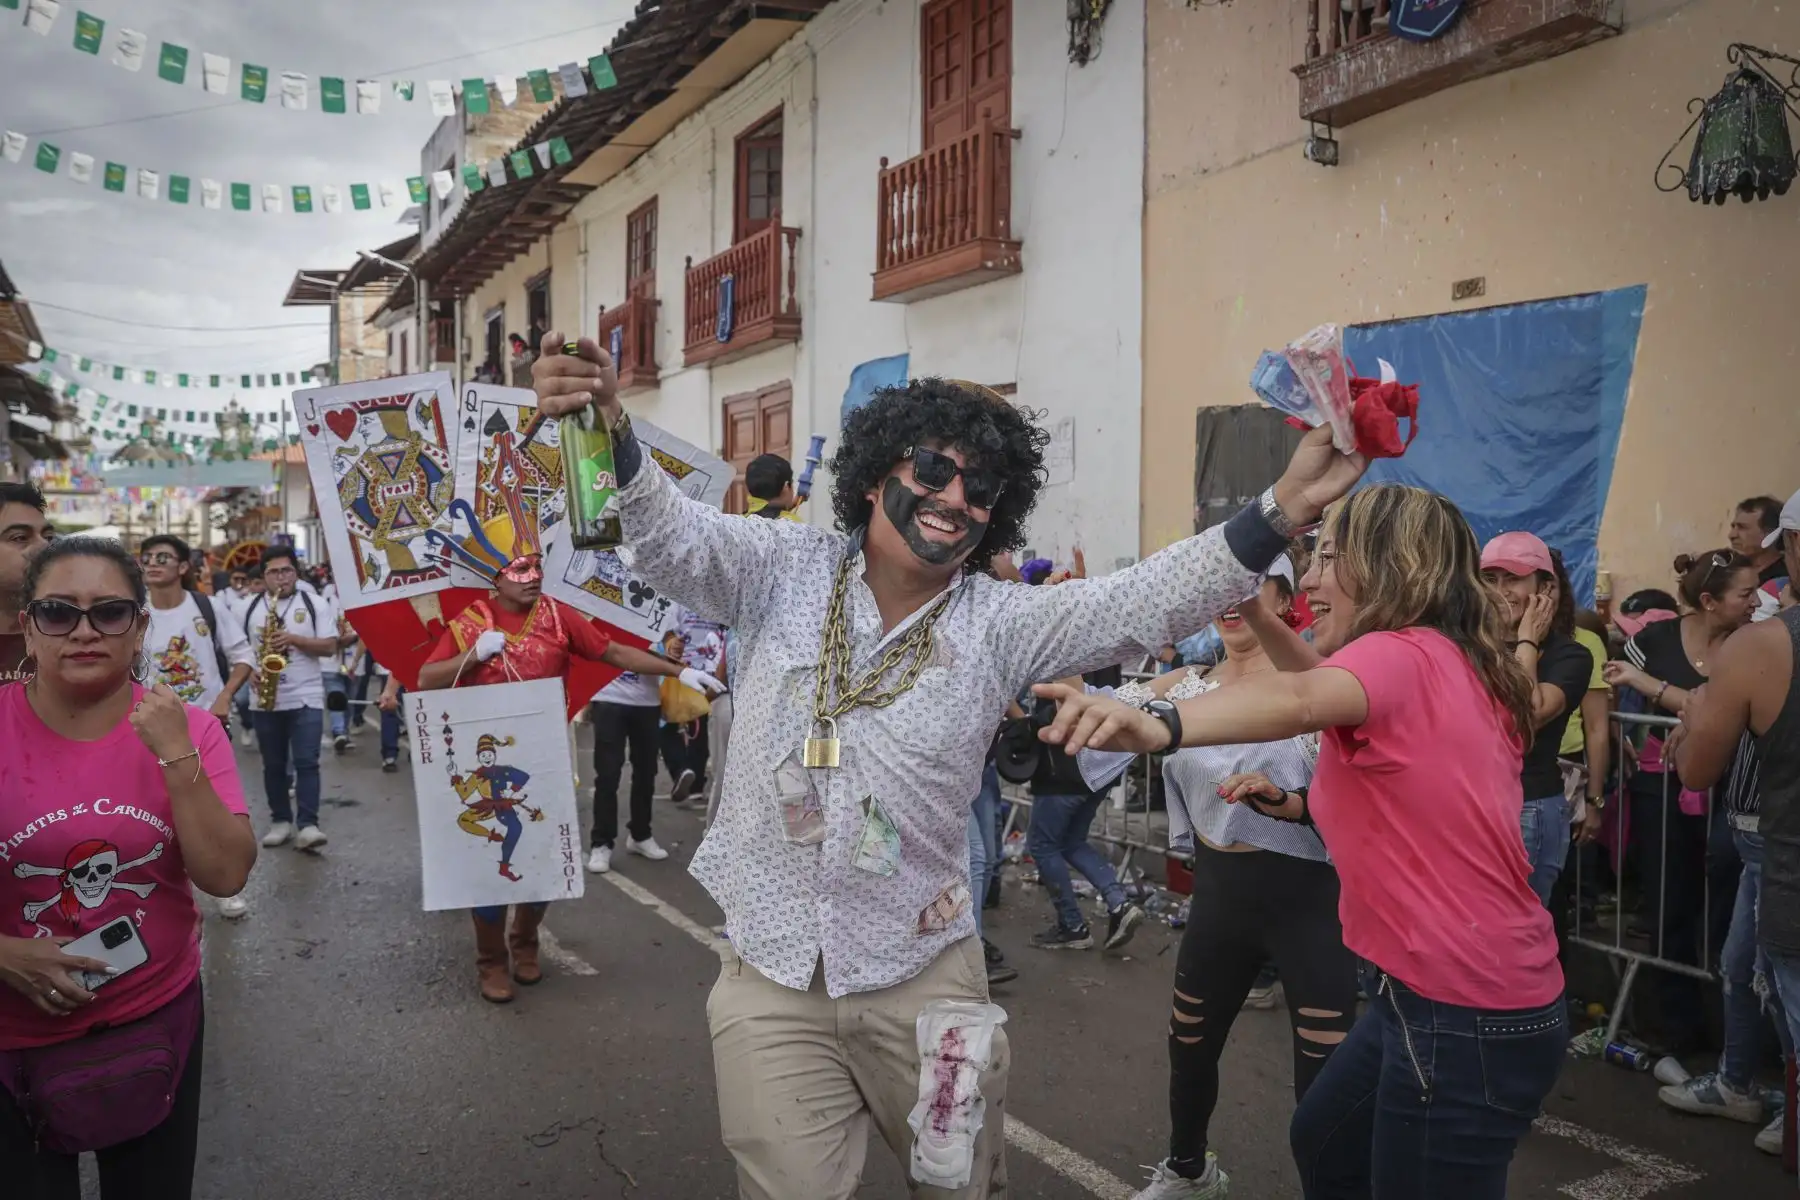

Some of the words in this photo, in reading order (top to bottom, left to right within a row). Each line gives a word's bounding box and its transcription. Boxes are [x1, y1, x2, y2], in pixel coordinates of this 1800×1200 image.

[304, 397, 316, 421] J
[465, 389, 478, 413] Q
[648, 610, 665, 632] K
[415, 698, 433, 764] JOKER
[0, 808, 67, 862] PIRATES
[93, 798, 175, 844] CARIBBEAN
[558, 823, 574, 892] JOKER
